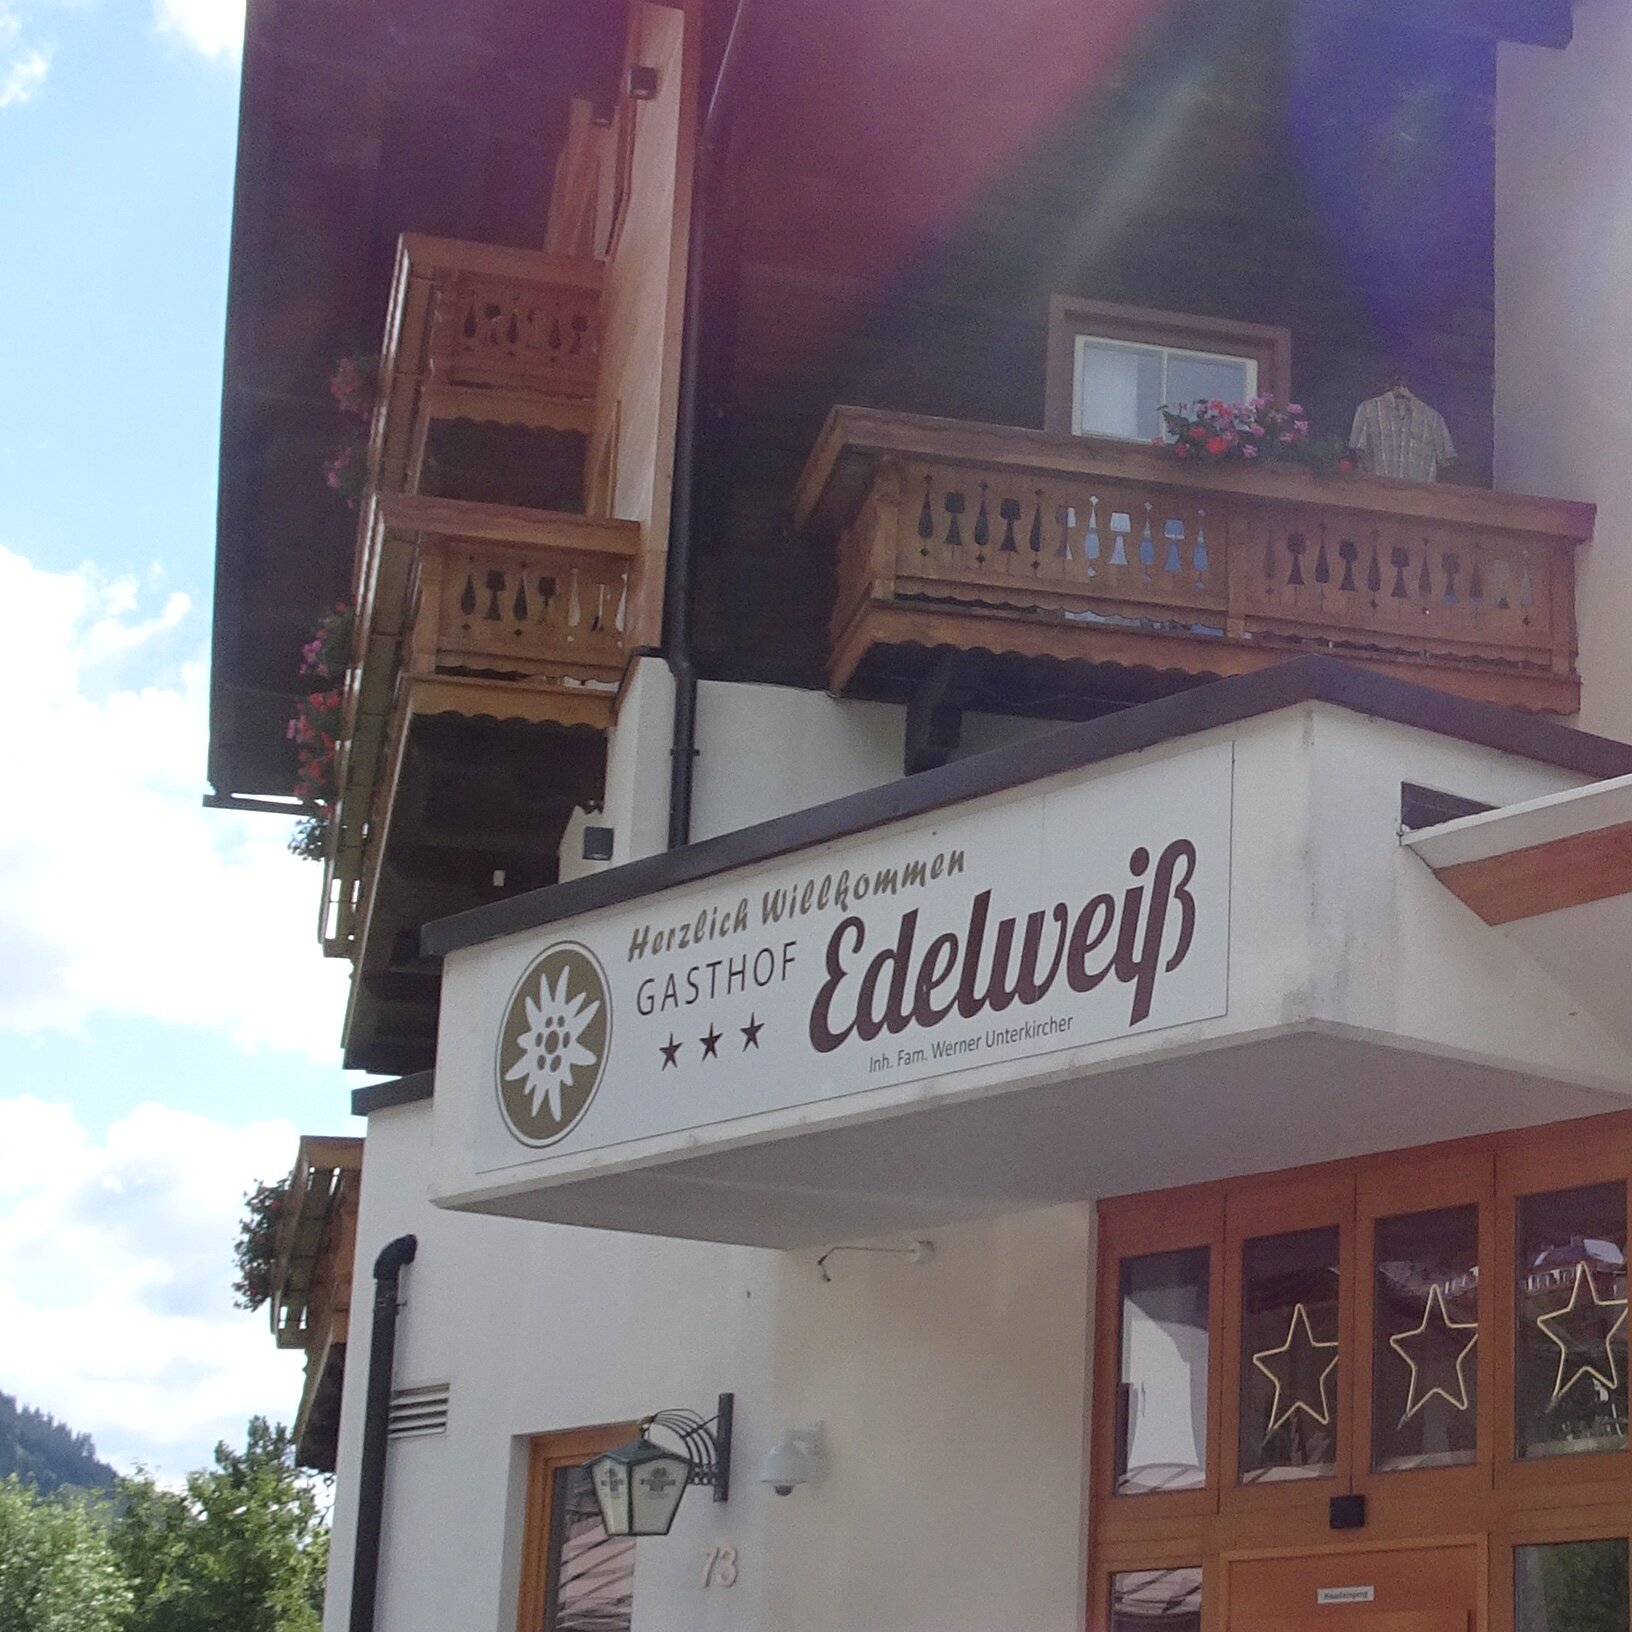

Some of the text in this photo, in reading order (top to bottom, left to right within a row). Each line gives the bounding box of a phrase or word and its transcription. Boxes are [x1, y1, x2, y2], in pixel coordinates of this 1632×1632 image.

[627, 849, 966, 962] Herzlich Willkommen
[636, 838, 1198, 1054] GASTHOF Edelweiß
[869, 1015, 1074, 1073] Inh. Fam. Werner Unterkircher
[701, 1545, 739, 1589] 73
